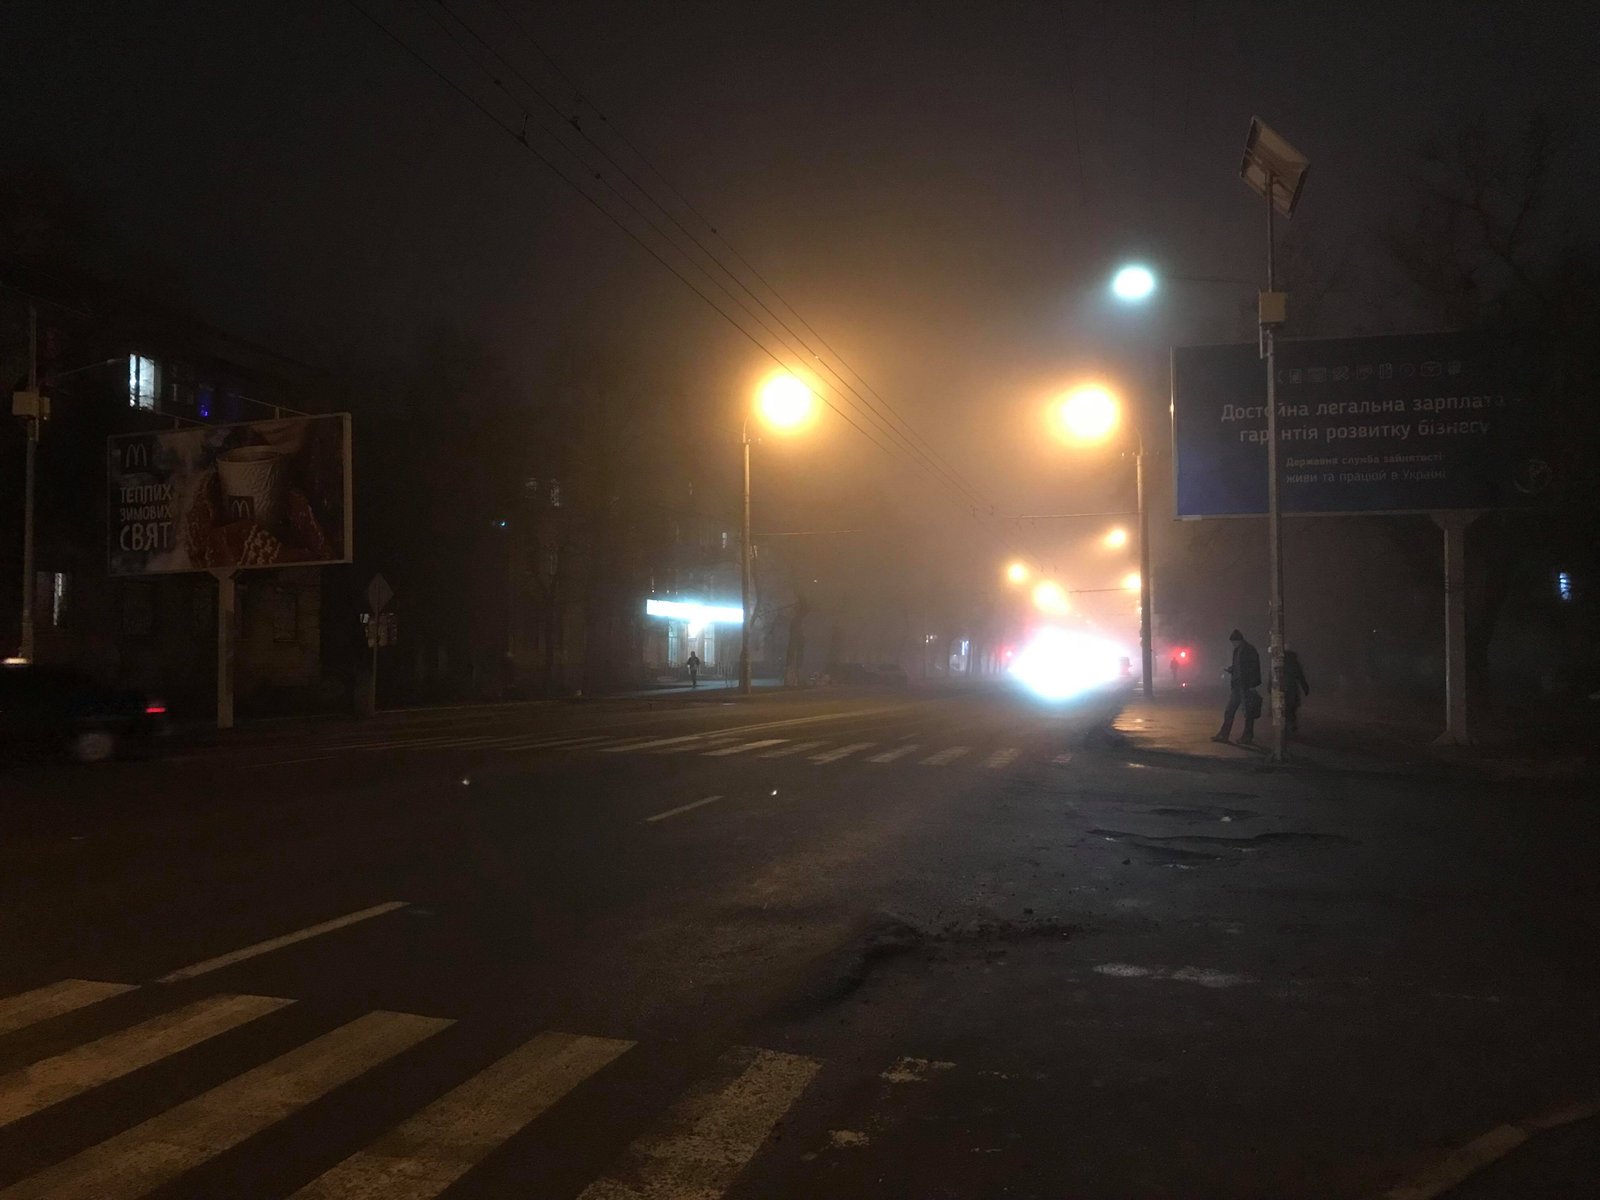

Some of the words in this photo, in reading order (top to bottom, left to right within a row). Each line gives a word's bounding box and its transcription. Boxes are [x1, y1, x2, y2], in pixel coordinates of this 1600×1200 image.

[1316, 399, 1405, 416] легальна
[1240, 425, 1318, 445] гарнтія
[1326, 423, 1411, 443] розвитку
[1418, 419, 1491, 437] бізнесу
[1341, 455, 1380, 466] служба
[1286, 473, 1317, 483] живи
[1322, 472, 1335, 482] та
[1339, 469, 1386, 484] працюй
[1391, 471, 1398, 480] в
[119, 484, 172, 504] ТЕПЛИХ
[119, 504, 172, 522] ЗИМОВИХ
[119, 522, 172, 551] СВЯТ
